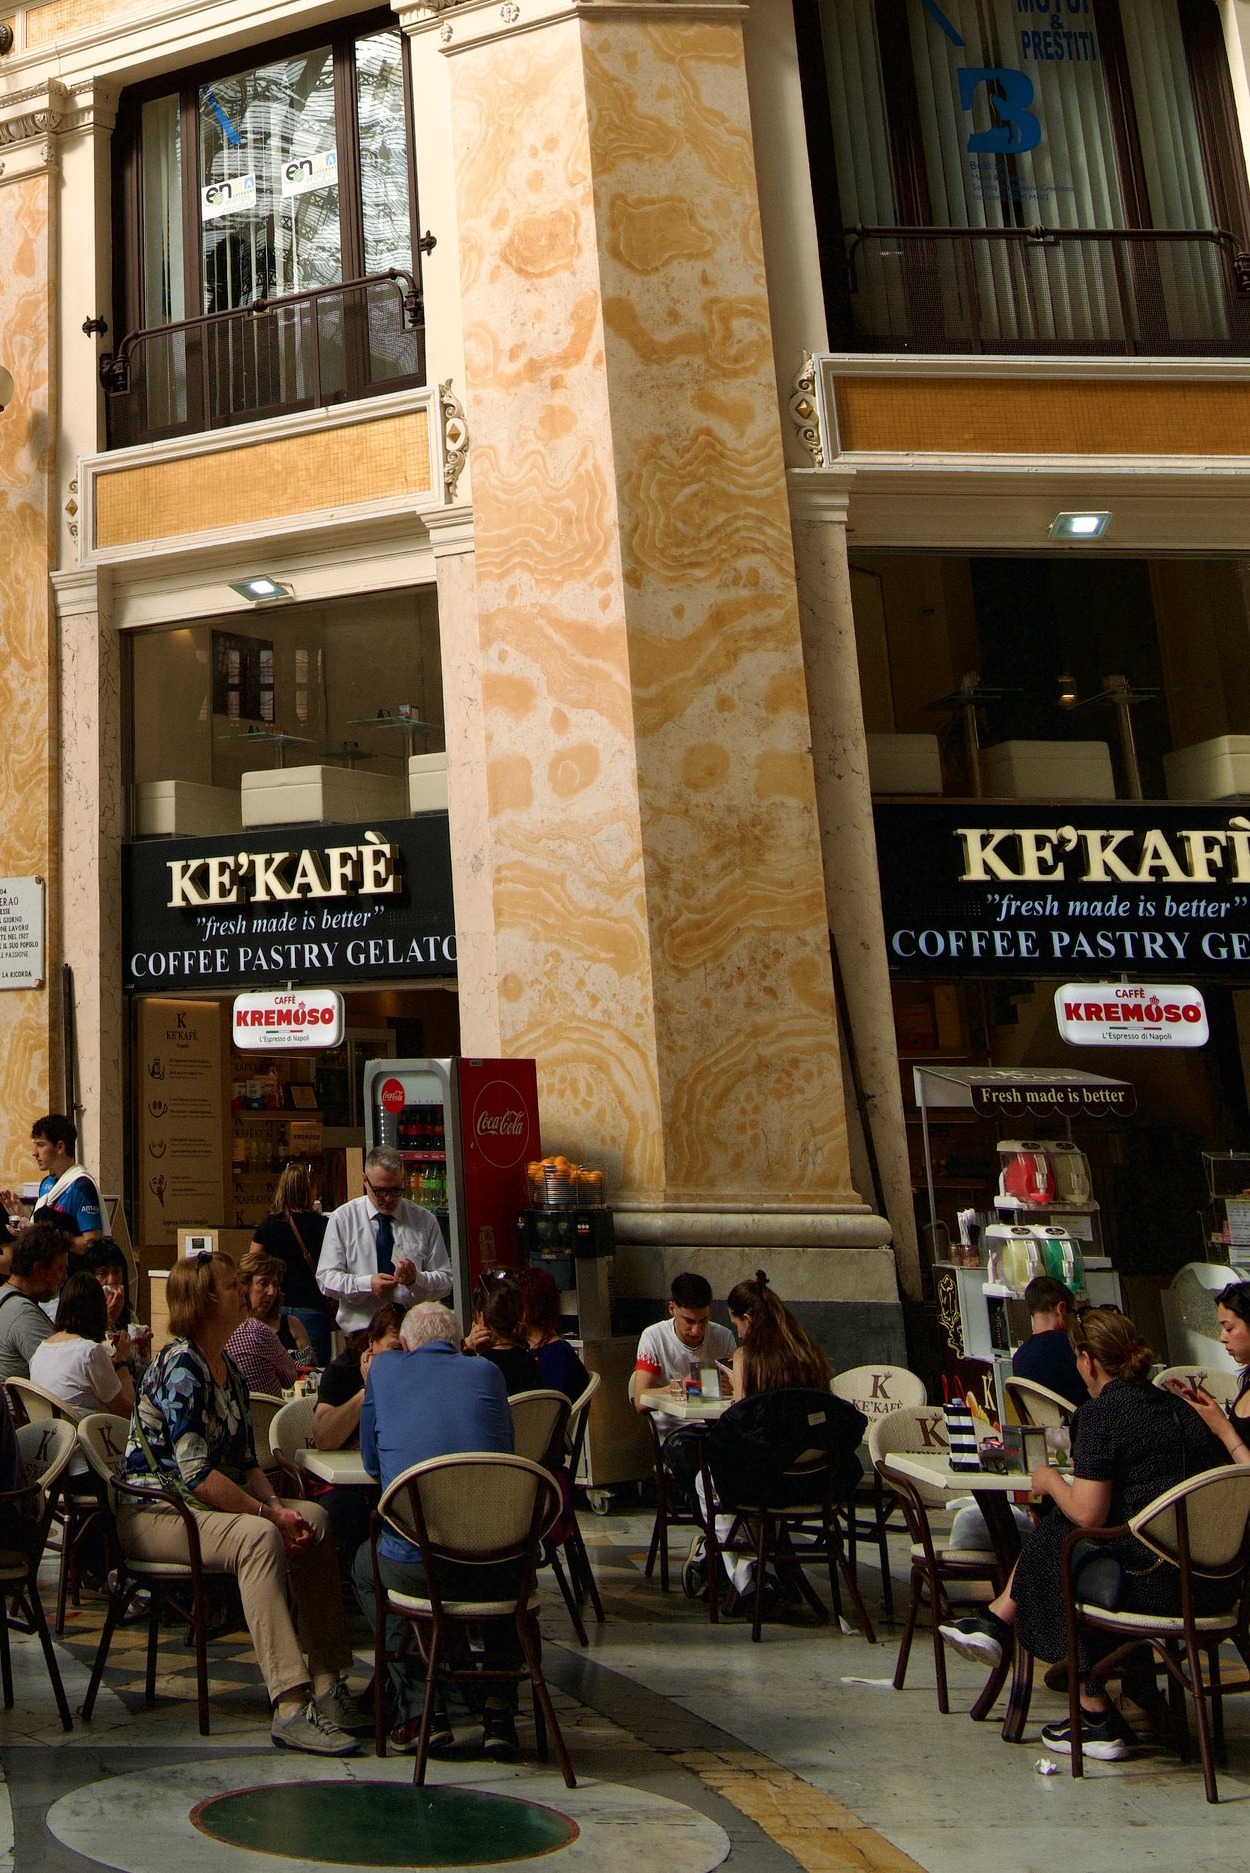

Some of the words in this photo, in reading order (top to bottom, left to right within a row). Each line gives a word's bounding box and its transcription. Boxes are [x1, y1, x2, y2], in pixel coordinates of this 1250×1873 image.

[1051, 14, 1063, 29] &
[1020, 31, 1096, 60] PRESTITI
[166, 831, 402, 907] KE'KAFÈ
[1068, 894, 1130, 916] made
[1138, 895, 1156, 916] is
[252, 911, 297, 933] made
[302, 910, 316, 930] is
[891, 929, 1040, 958] COFFEE
[1051, 930, 1190, 960] PASTRY
[130, 948, 230, 978] COFFEE
[238, 941, 339, 972] PASTRY
[274, 994, 296, 1005] CAFFÈ
[1115, 987, 1145, 998] CAFFÈ
[177, 1013, 187, 1028] K
[236, 1007, 334, 1027] KREMOSO
[1064, 1002, 1201, 1023] KREMOSO
[293, 1035, 310, 1043] Napoli
[1102, 1032, 1139, 1041] L'Espresso
[1141, 1032, 1148, 1040] di
[1150, 1032, 1172, 1041] Napoli
[981, 1087, 1022, 1103] Fresh
[1025, 1088, 1064, 1103] made
[1068, 1088, 1080, 1103] is
[1083, 1088, 1125, 1103] better
[477, 1109, 524, 1136] Coca-Cola
[870, 1374, 891, 1398] K
[981, 1375, 996, 1411] K
[1185, 1375, 1216, 1399] K
[98, 1426, 123, 1456] K
[915, 1417, 950, 1447] K
[34, 1429, 57, 1461] K
